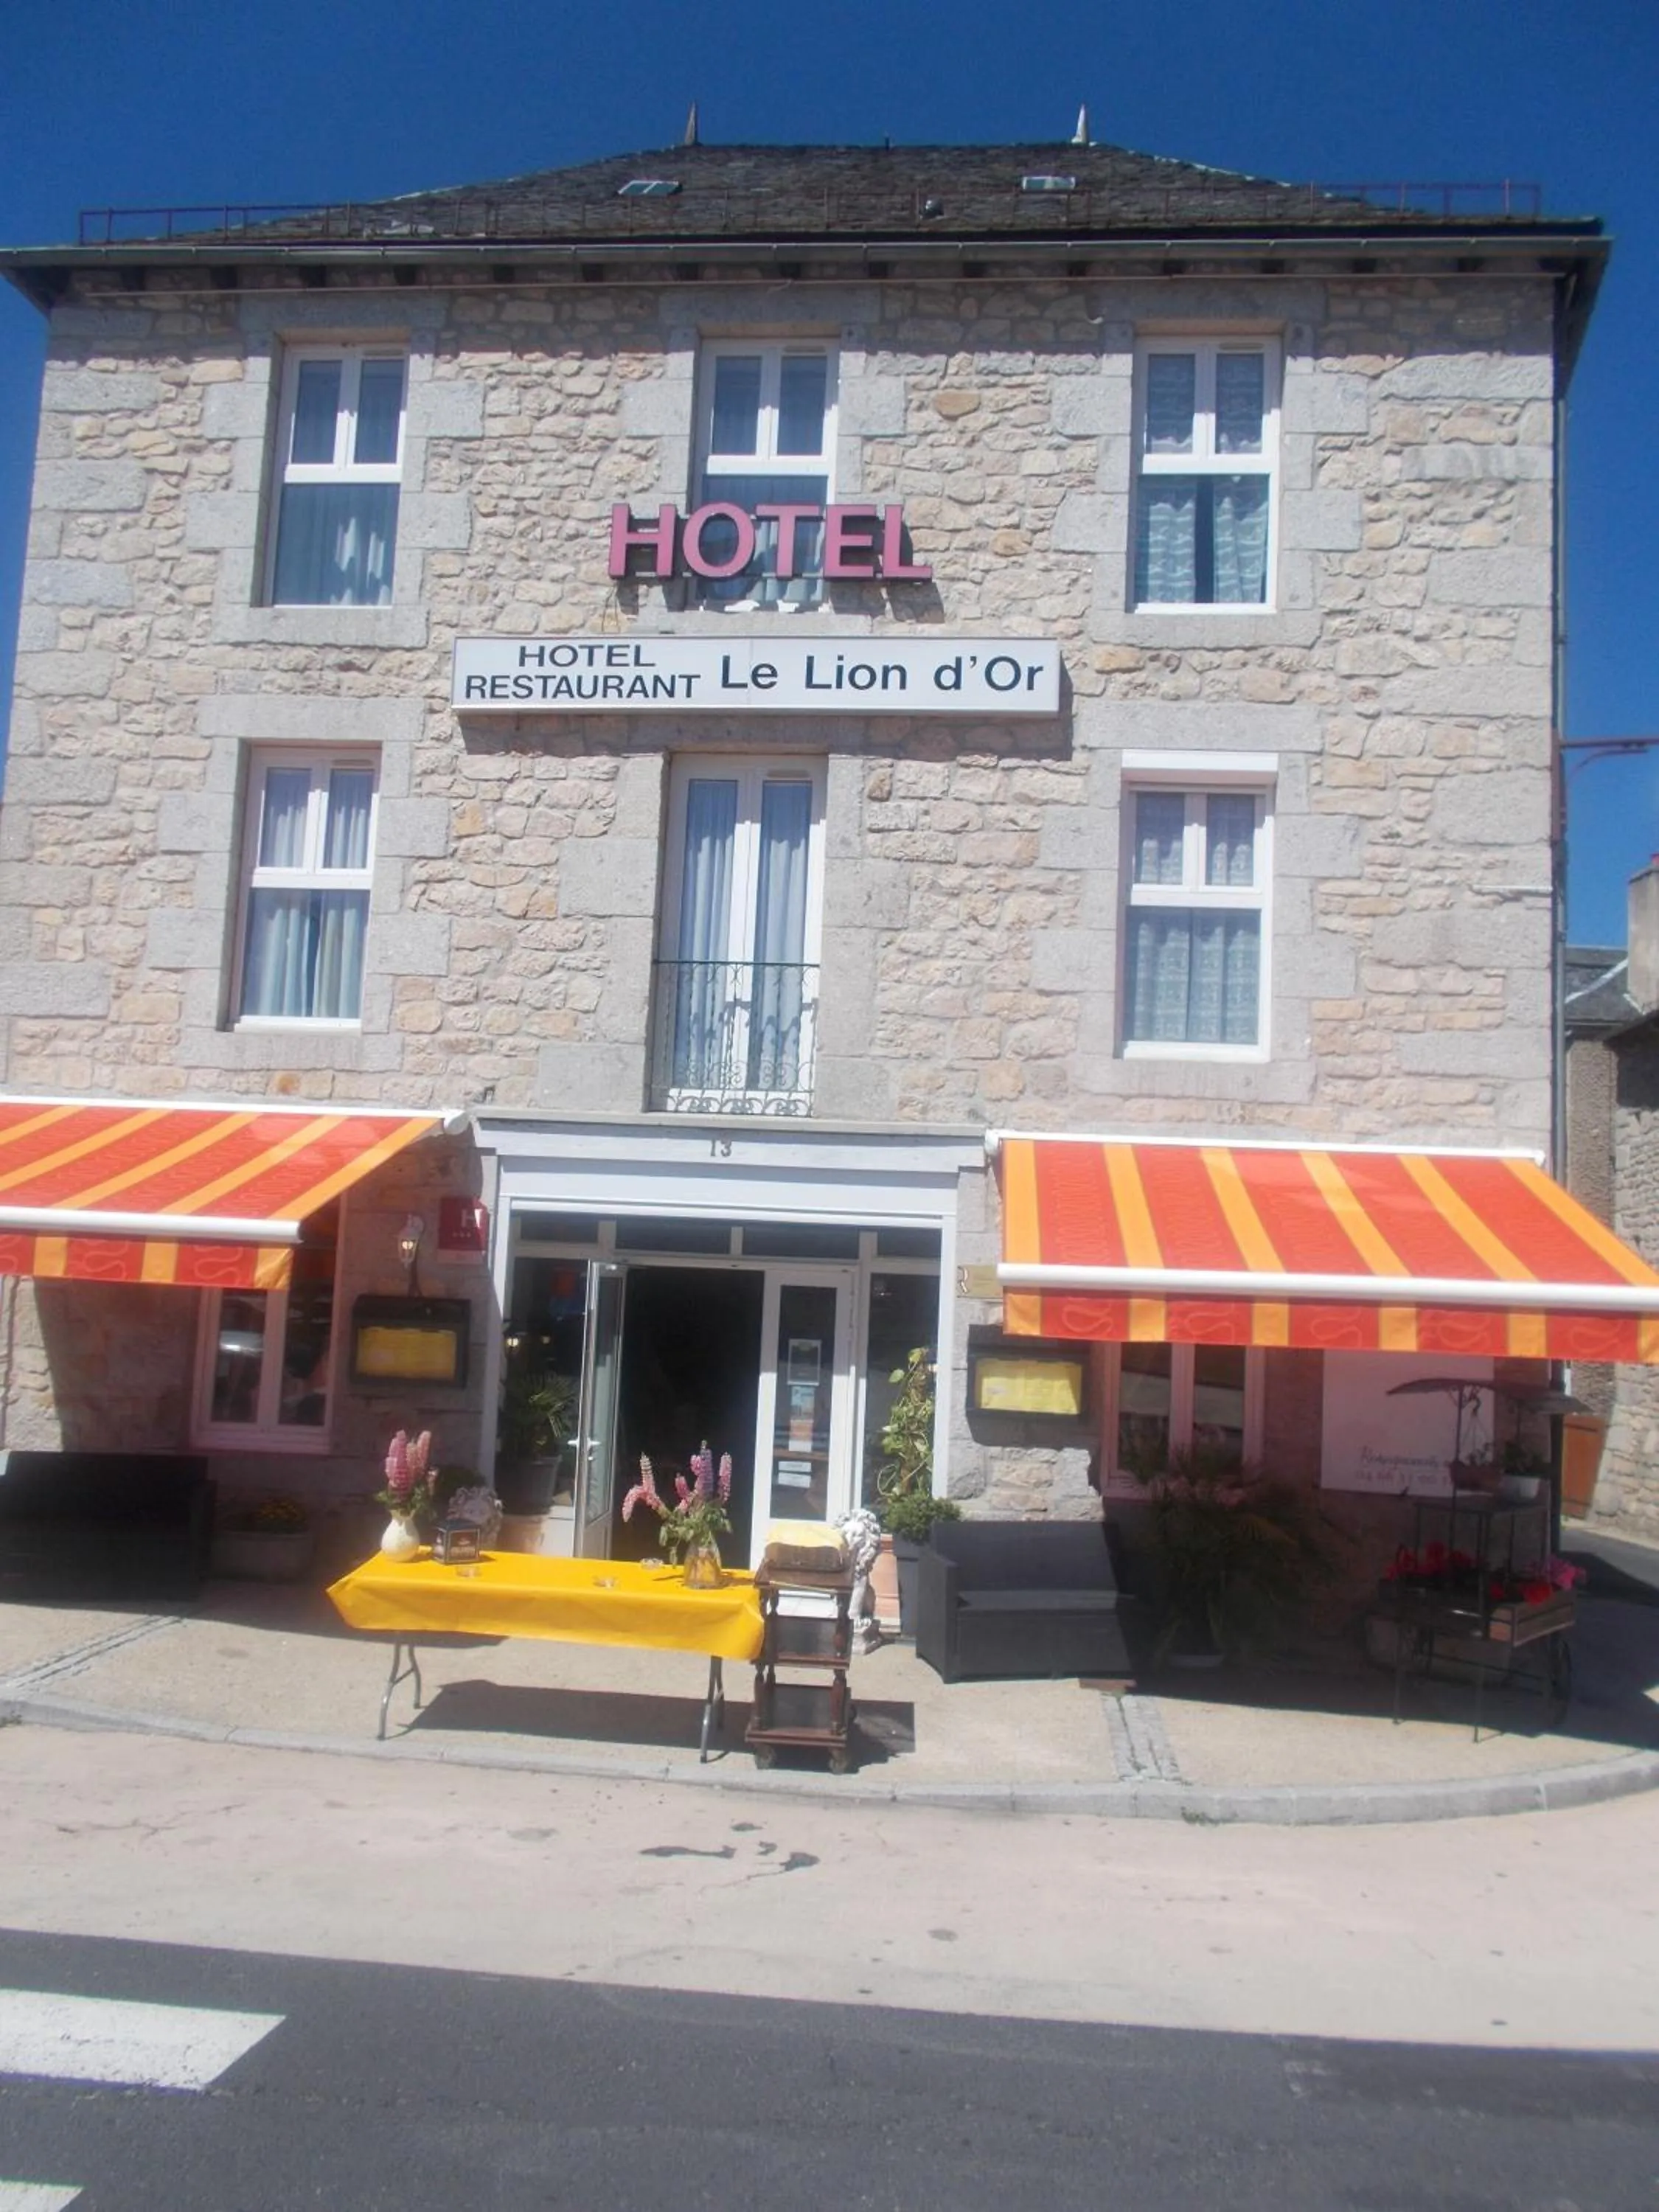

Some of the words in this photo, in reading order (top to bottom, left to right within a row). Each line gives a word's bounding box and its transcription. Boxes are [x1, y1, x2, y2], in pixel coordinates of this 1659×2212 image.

[608, 503, 932, 579] HOTEL
[518, 644, 656, 667] HOTEL
[720, 655, 779, 689] Le
[805, 655, 908, 691] Lion
[933, 655, 1045, 692] d'Or
[465, 674, 702, 700] RESTAURANT
[710, 1138, 732, 1157] 13
